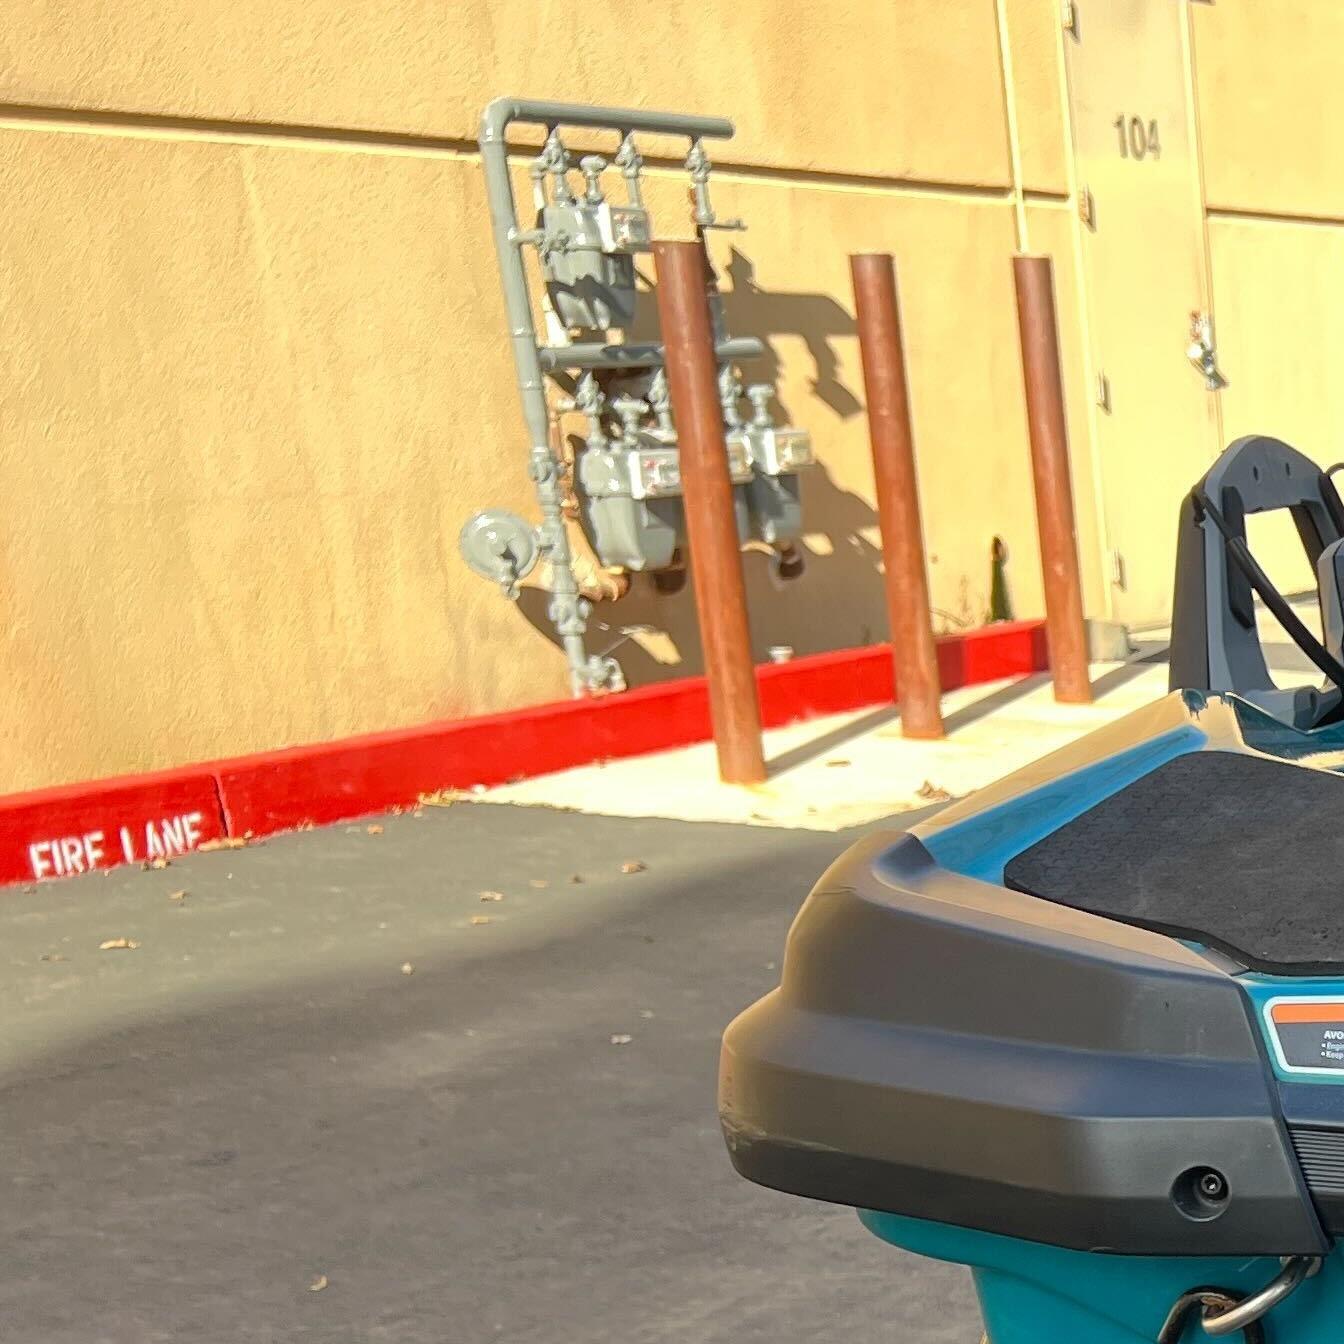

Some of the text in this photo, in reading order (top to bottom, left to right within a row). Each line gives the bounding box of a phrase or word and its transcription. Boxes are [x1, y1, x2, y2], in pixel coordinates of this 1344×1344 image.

[1112, 113, 1161, 161] 104
[29, 812, 202, 878] FIRE LANE
